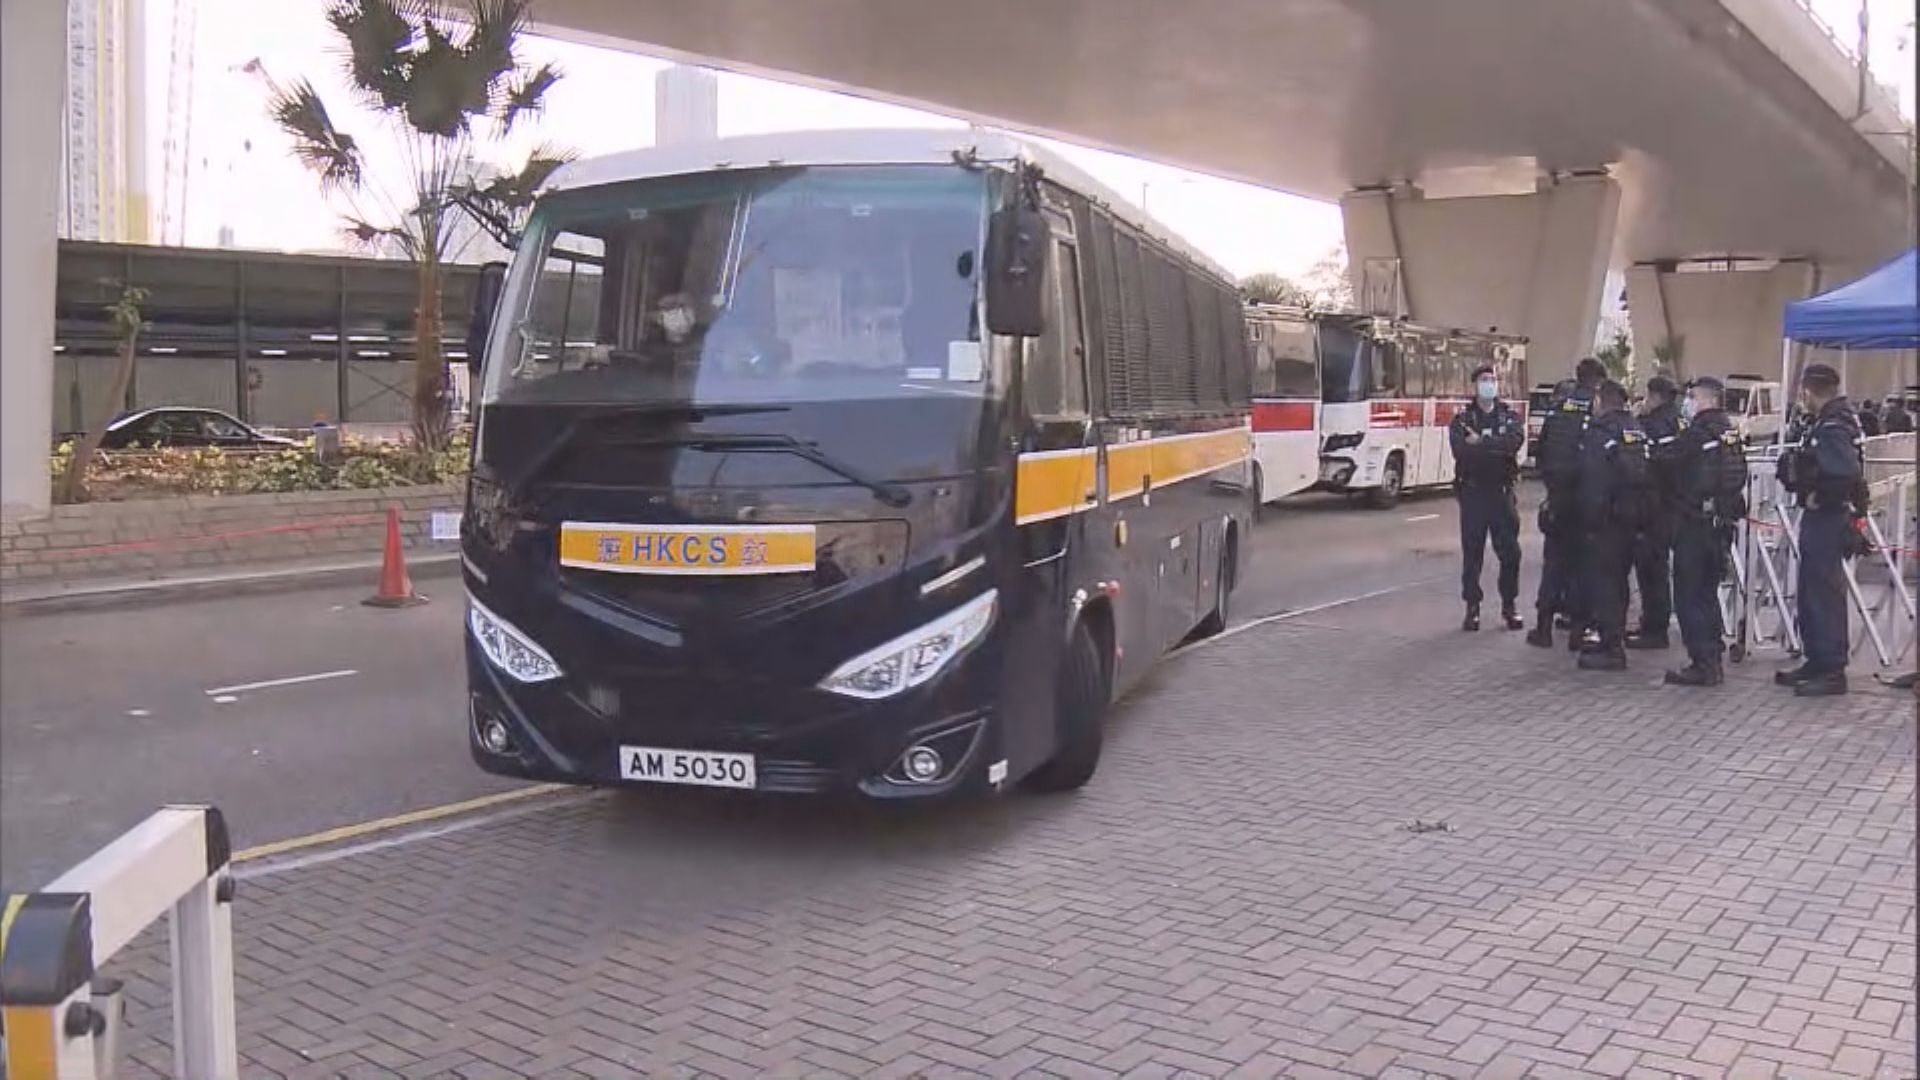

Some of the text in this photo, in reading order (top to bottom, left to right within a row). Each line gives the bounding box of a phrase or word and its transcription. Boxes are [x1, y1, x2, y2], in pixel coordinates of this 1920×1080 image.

[633, 536, 728, 564] HKCS
[630, 752, 746, 783] AM 5030
